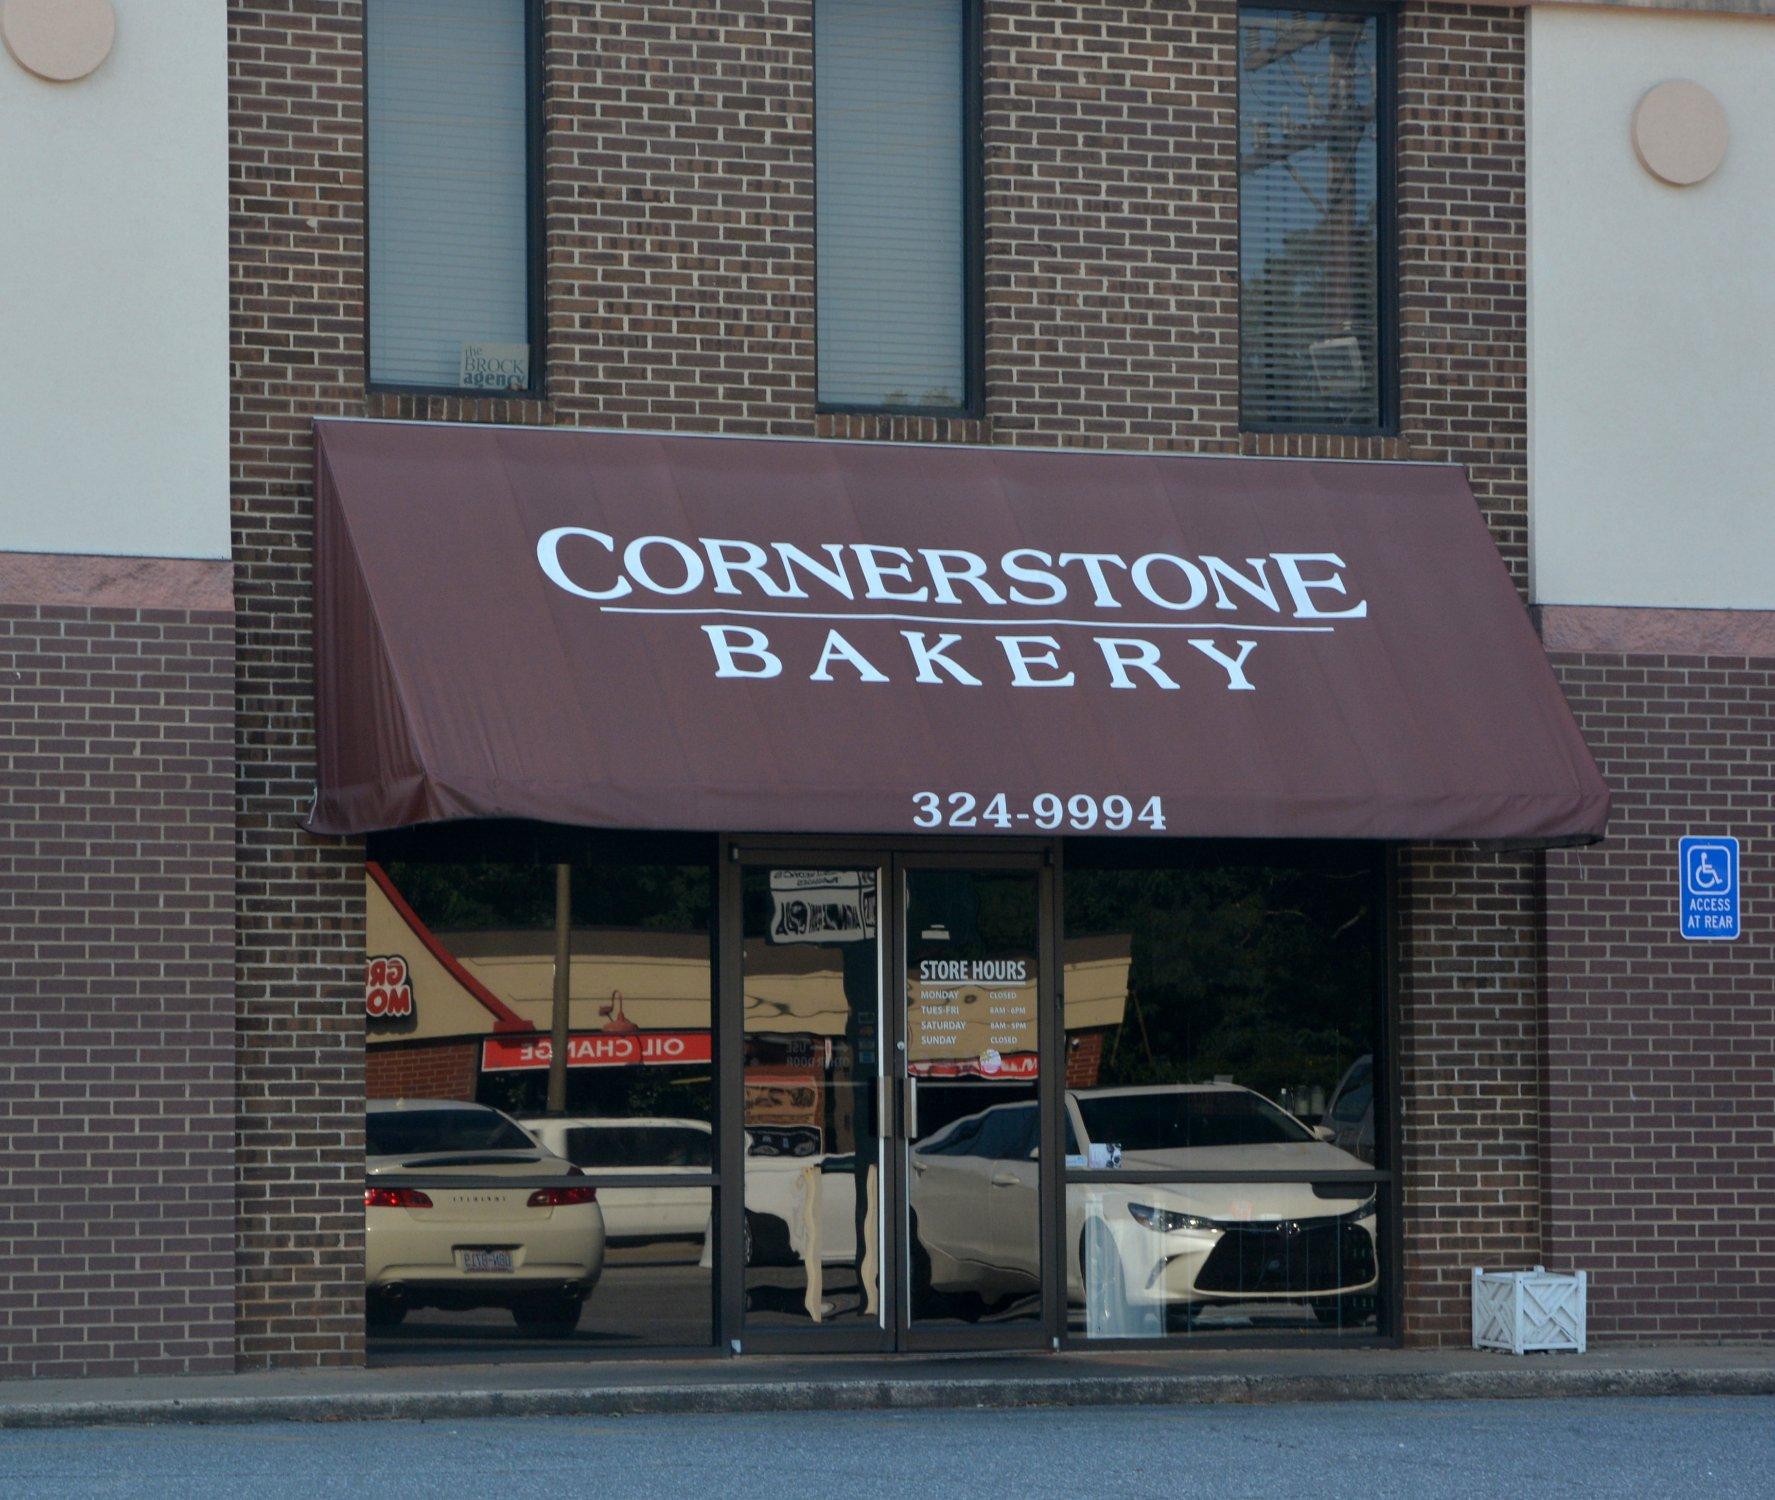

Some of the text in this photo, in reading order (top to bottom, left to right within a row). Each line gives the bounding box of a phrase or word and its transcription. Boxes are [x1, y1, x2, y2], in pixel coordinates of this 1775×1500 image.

[465, 357, 525, 374] BROCK
[464, 371, 525, 387] agency
[535, 526, 1368, 619] CORNERSTONE
[701, 624, 1258, 692] BAKERY
[911, 792, 1168, 832] 324-9994
[1689, 897, 1731, 911] ACCESS
[1687, 915, 1733, 929] AT REAR
[919, 960, 1027, 980] STORE HOURS
[920, 990, 1017, 1000] MONDAY CLOSED
[920, 1005, 959, 1016] TUES-FRI
[920, 1020, 966, 1031] SATURDAY
[921, 1036, 1018, 1046] SUNDAY CLOSED
